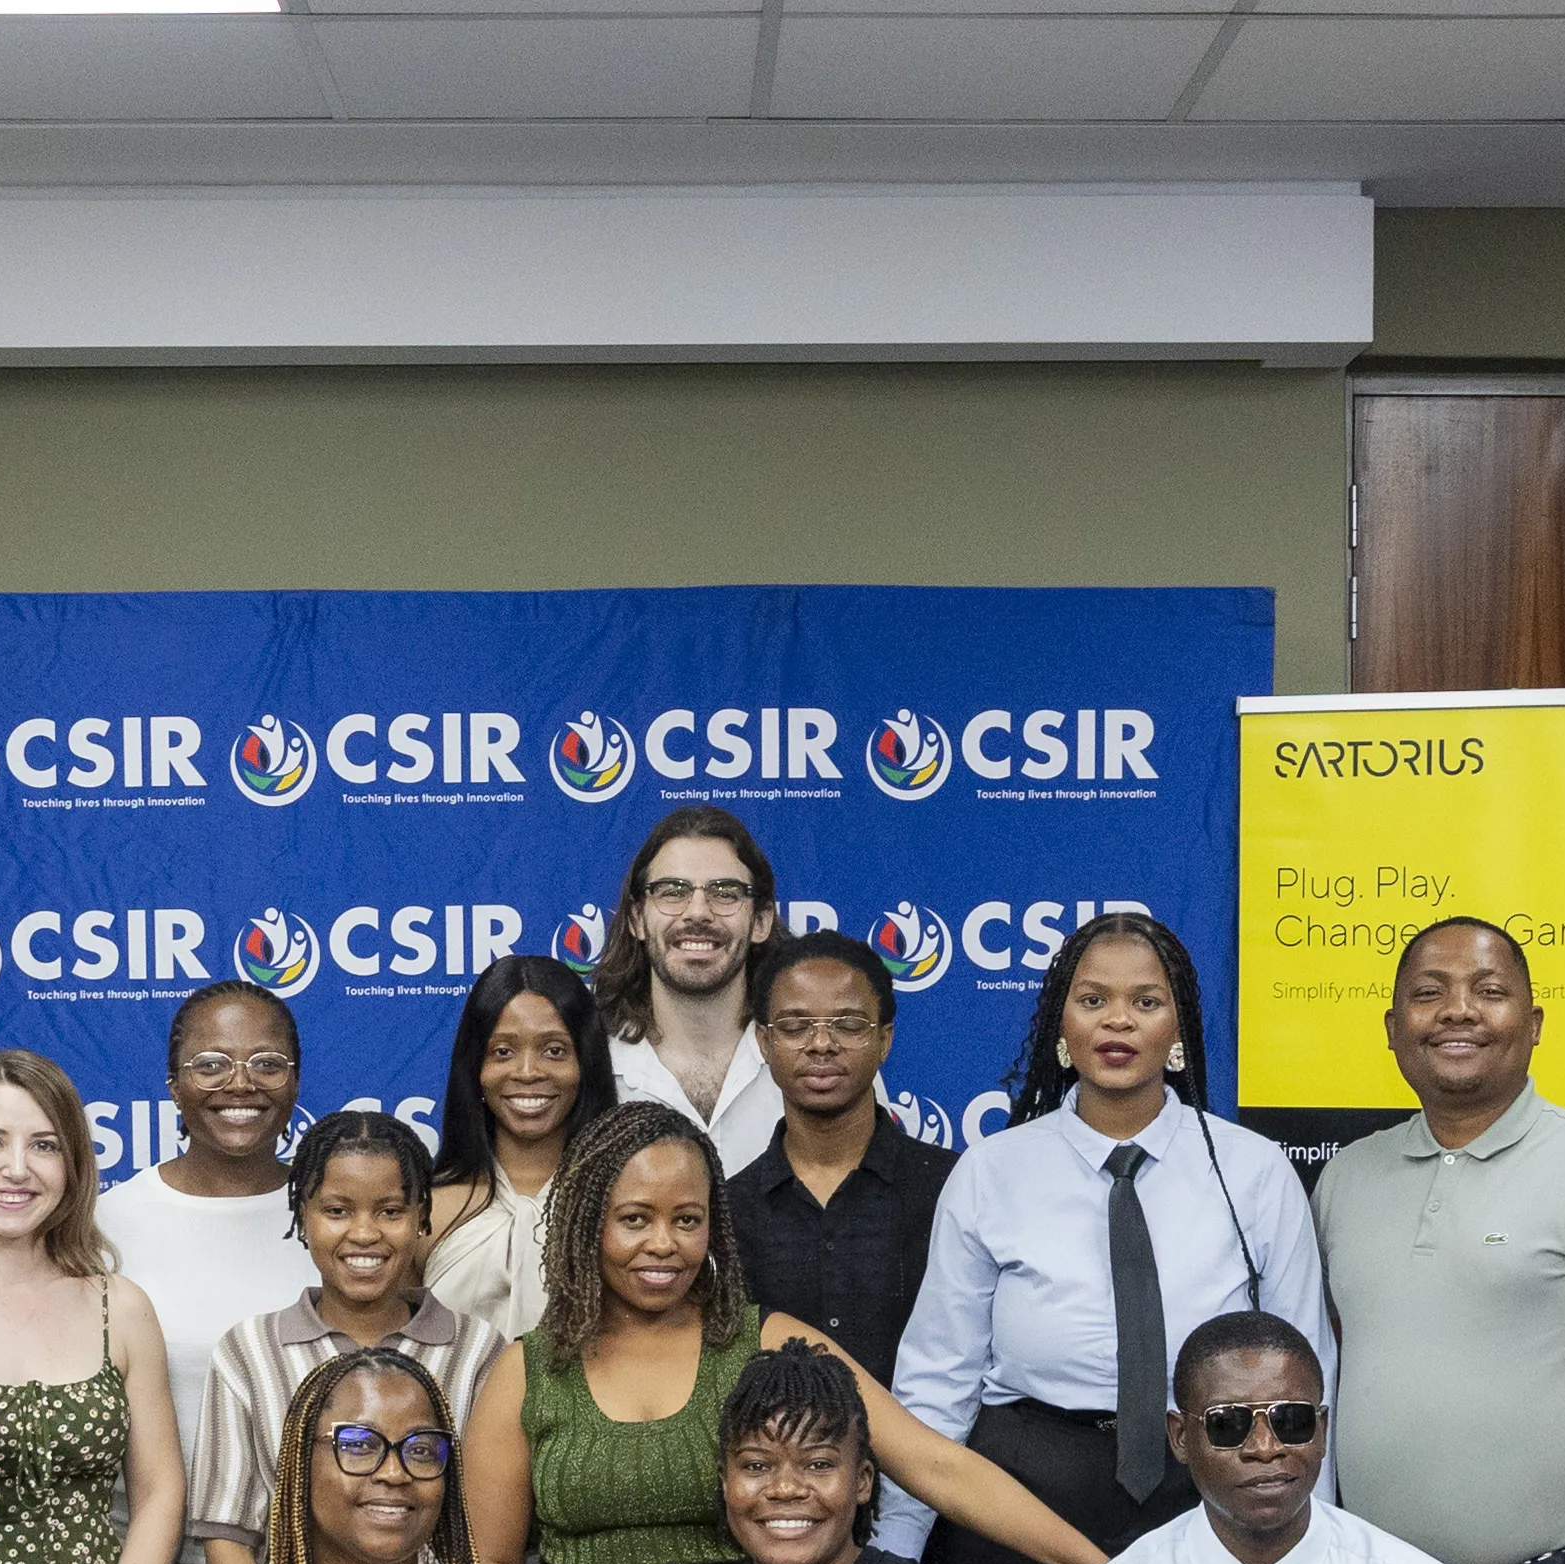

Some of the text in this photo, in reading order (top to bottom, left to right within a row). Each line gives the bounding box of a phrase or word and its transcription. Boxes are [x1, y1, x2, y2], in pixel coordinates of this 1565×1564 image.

[5, 715, 209, 789] CSIR
[325, 712, 527, 784] CSIR
[644, 707, 844, 780] CSIR
[961, 708, 1160, 780] CSIR
[1274, 737, 1485, 779] SARTORIUS
[22, 795, 206, 810] Touching lives through innovation
[342, 791, 525, 805] Touching lives through innovation
[660, 787, 841, 801] Touching lives through innovation
[976, 788, 1157, 801] Touching lives through innovation
[1277, 865, 1456, 908] Plug. Play.
[10, 908, 212, 981] CSIR
[1274, 914, 1421, 955] Change
[27, 987, 196, 1002] Touching lives through innovat
[344, 985, 395, 998] Touching
[397, 984, 422, 996] lives
[424, 984, 467, 997] through
[976, 979, 1025, 992] Touching
[1272, 981, 1345, 1003] Simplify
[1276, 1141, 1342, 1165] implif
